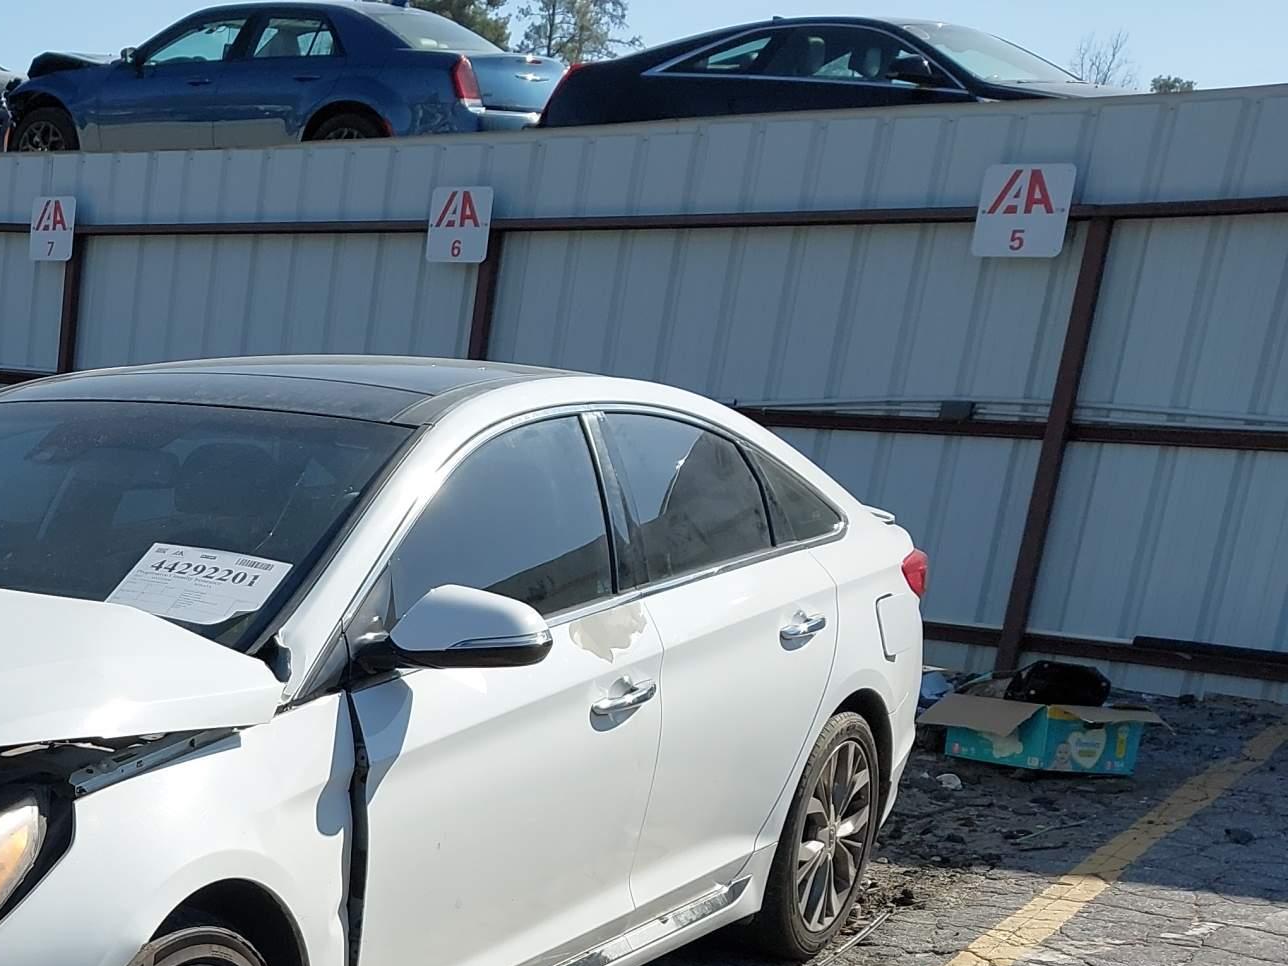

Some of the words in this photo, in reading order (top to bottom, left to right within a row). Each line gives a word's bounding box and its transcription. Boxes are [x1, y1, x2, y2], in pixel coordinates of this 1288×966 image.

[46, 241, 54, 257] 7
[451, 240, 462, 257] 6
[1009, 229, 1025, 251] 5
[151, 559, 260, 587] 44292201
